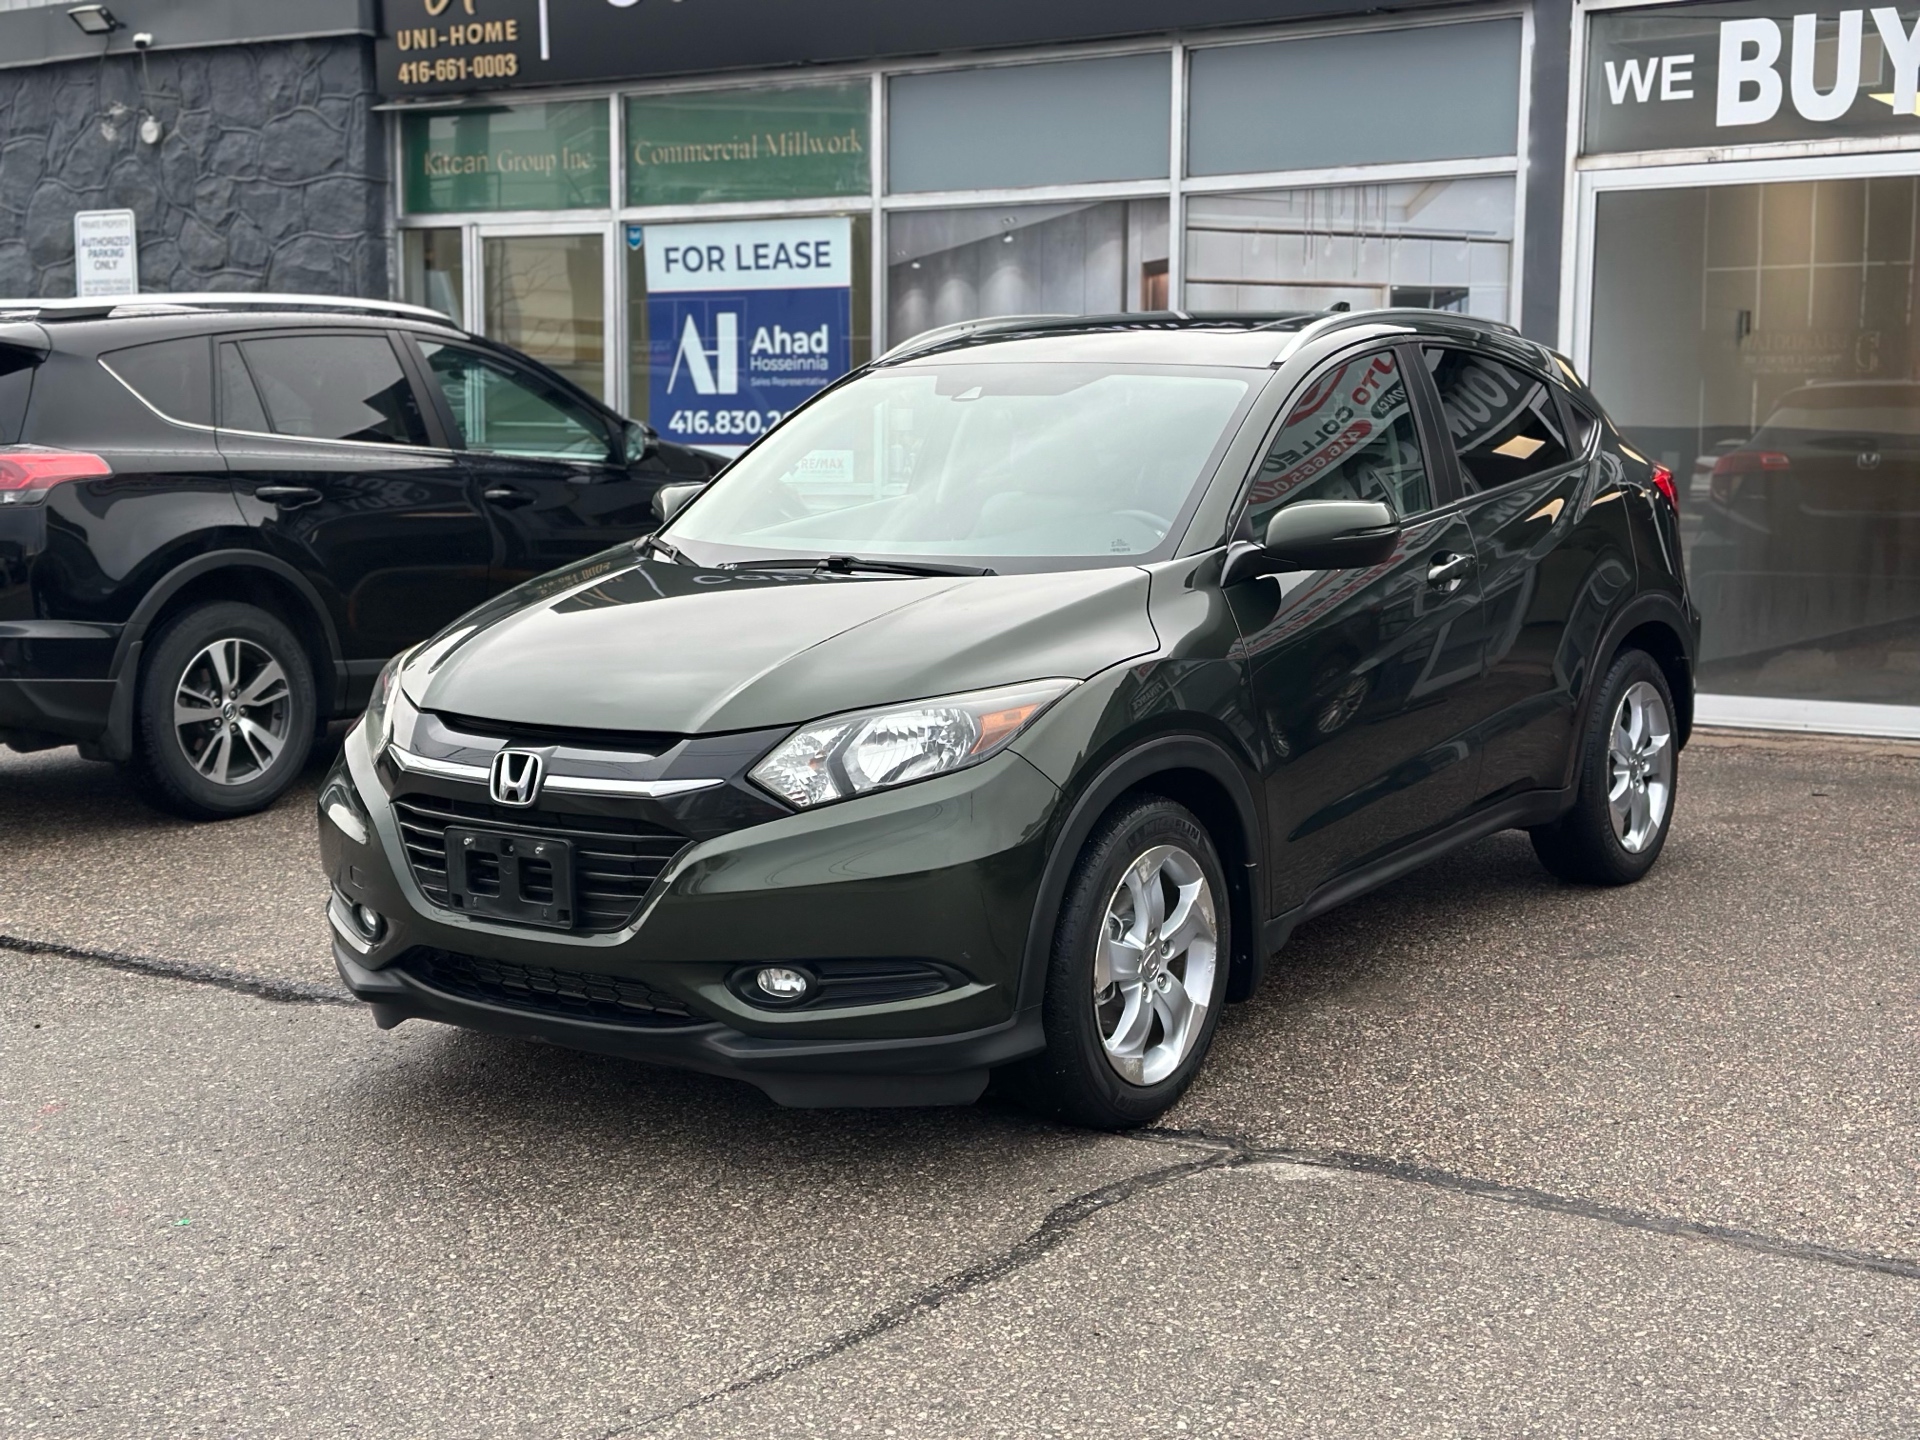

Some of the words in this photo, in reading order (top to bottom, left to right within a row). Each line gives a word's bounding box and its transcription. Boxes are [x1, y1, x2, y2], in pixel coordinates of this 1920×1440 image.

[397, 20, 518, 50] UNI-HOME
[398, 54, 518, 84] 416-661-0003
[1604, 54, 1695, 105] WE
[1716, 7, 1920, 127] BUY
[634, 135, 758, 166] Commercial
[766, 128, 863, 158] Millwork
[424, 151, 489, 175] Kitcan
[496, 148, 558, 177] Group
[81, 235, 130, 248] AUTHORIZED
[87, 247, 125, 259] PARKING
[93, 259, 118, 271] ONLY
[664, 245, 726, 274] FOR
[736, 240, 832, 271] LEASE
[750, 324, 829, 355] Ahad
[750, 355, 829, 371] Hosseinnia
[668, 410, 796, 435] 416.830.2
[801, 457, 845, 469] RE/MAX
